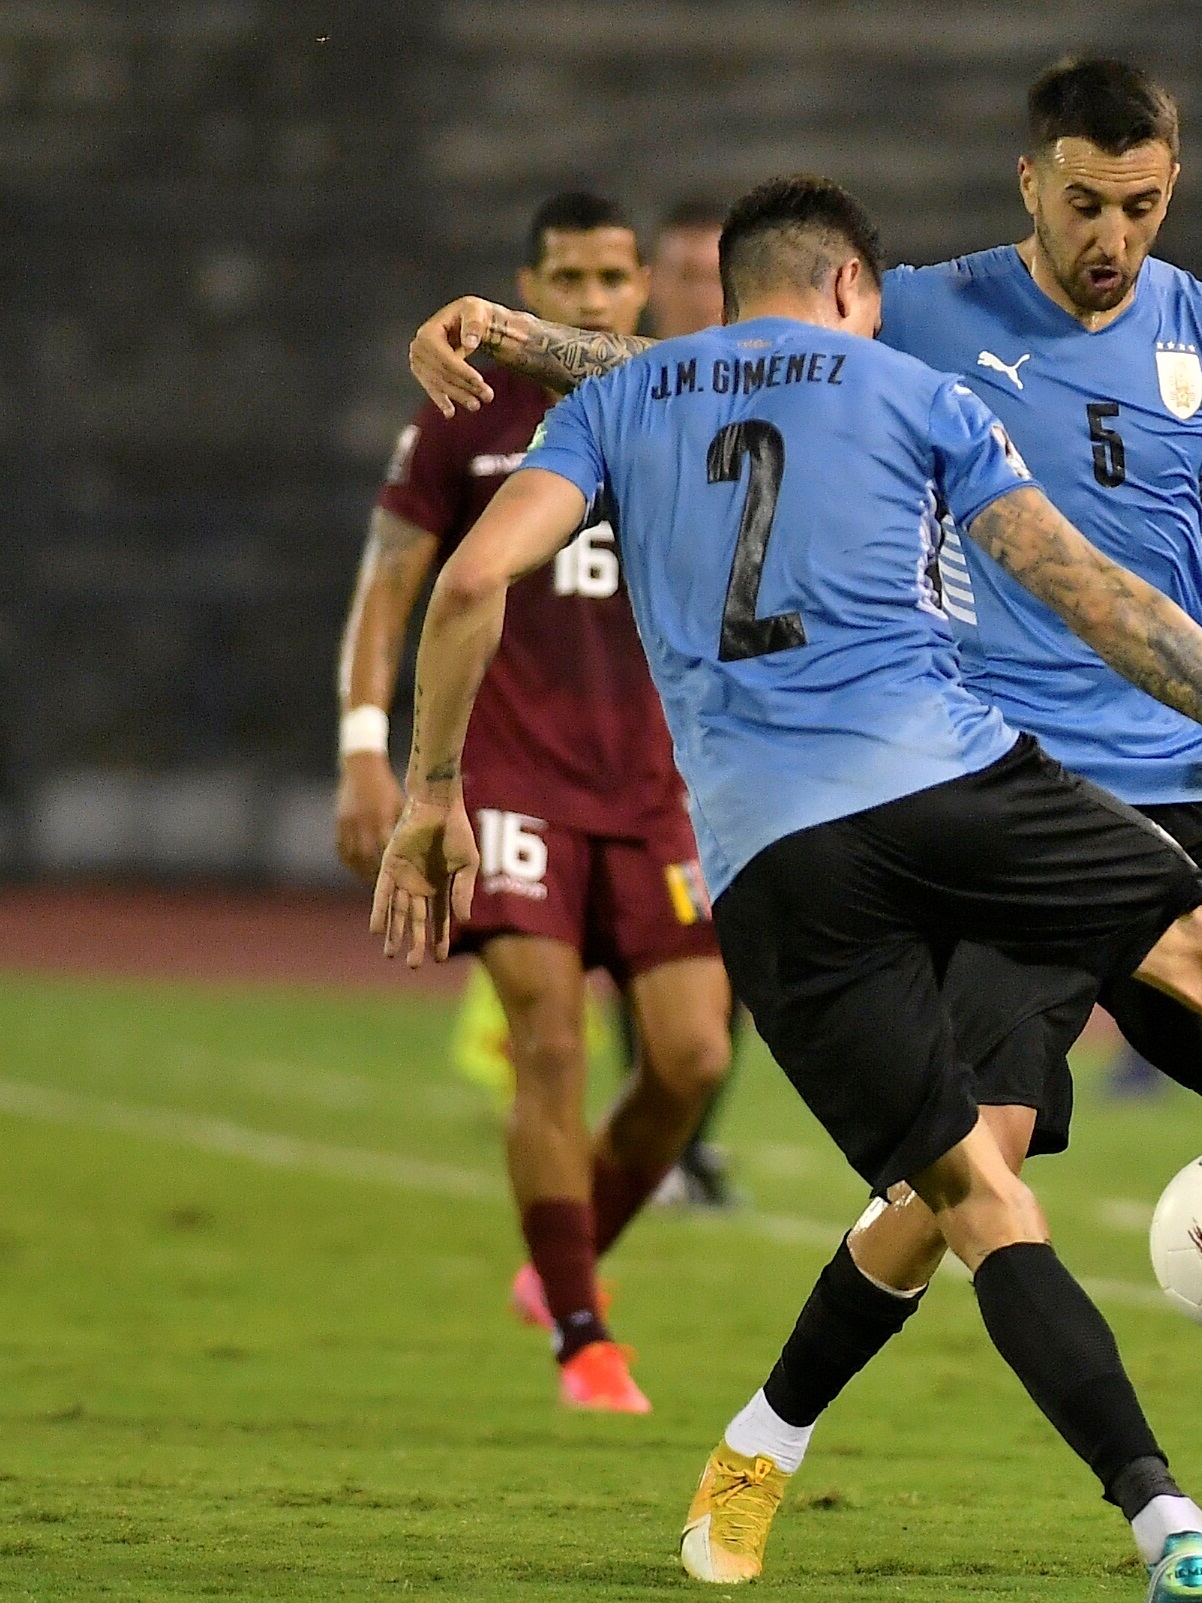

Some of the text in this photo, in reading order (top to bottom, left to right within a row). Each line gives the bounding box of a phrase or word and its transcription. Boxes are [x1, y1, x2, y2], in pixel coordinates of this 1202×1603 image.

[1087, 403, 1125, 488] 5
[554, 520, 620, 599] 16
[707, 418, 807, 662] 2
[476, 807, 548, 881] 16
